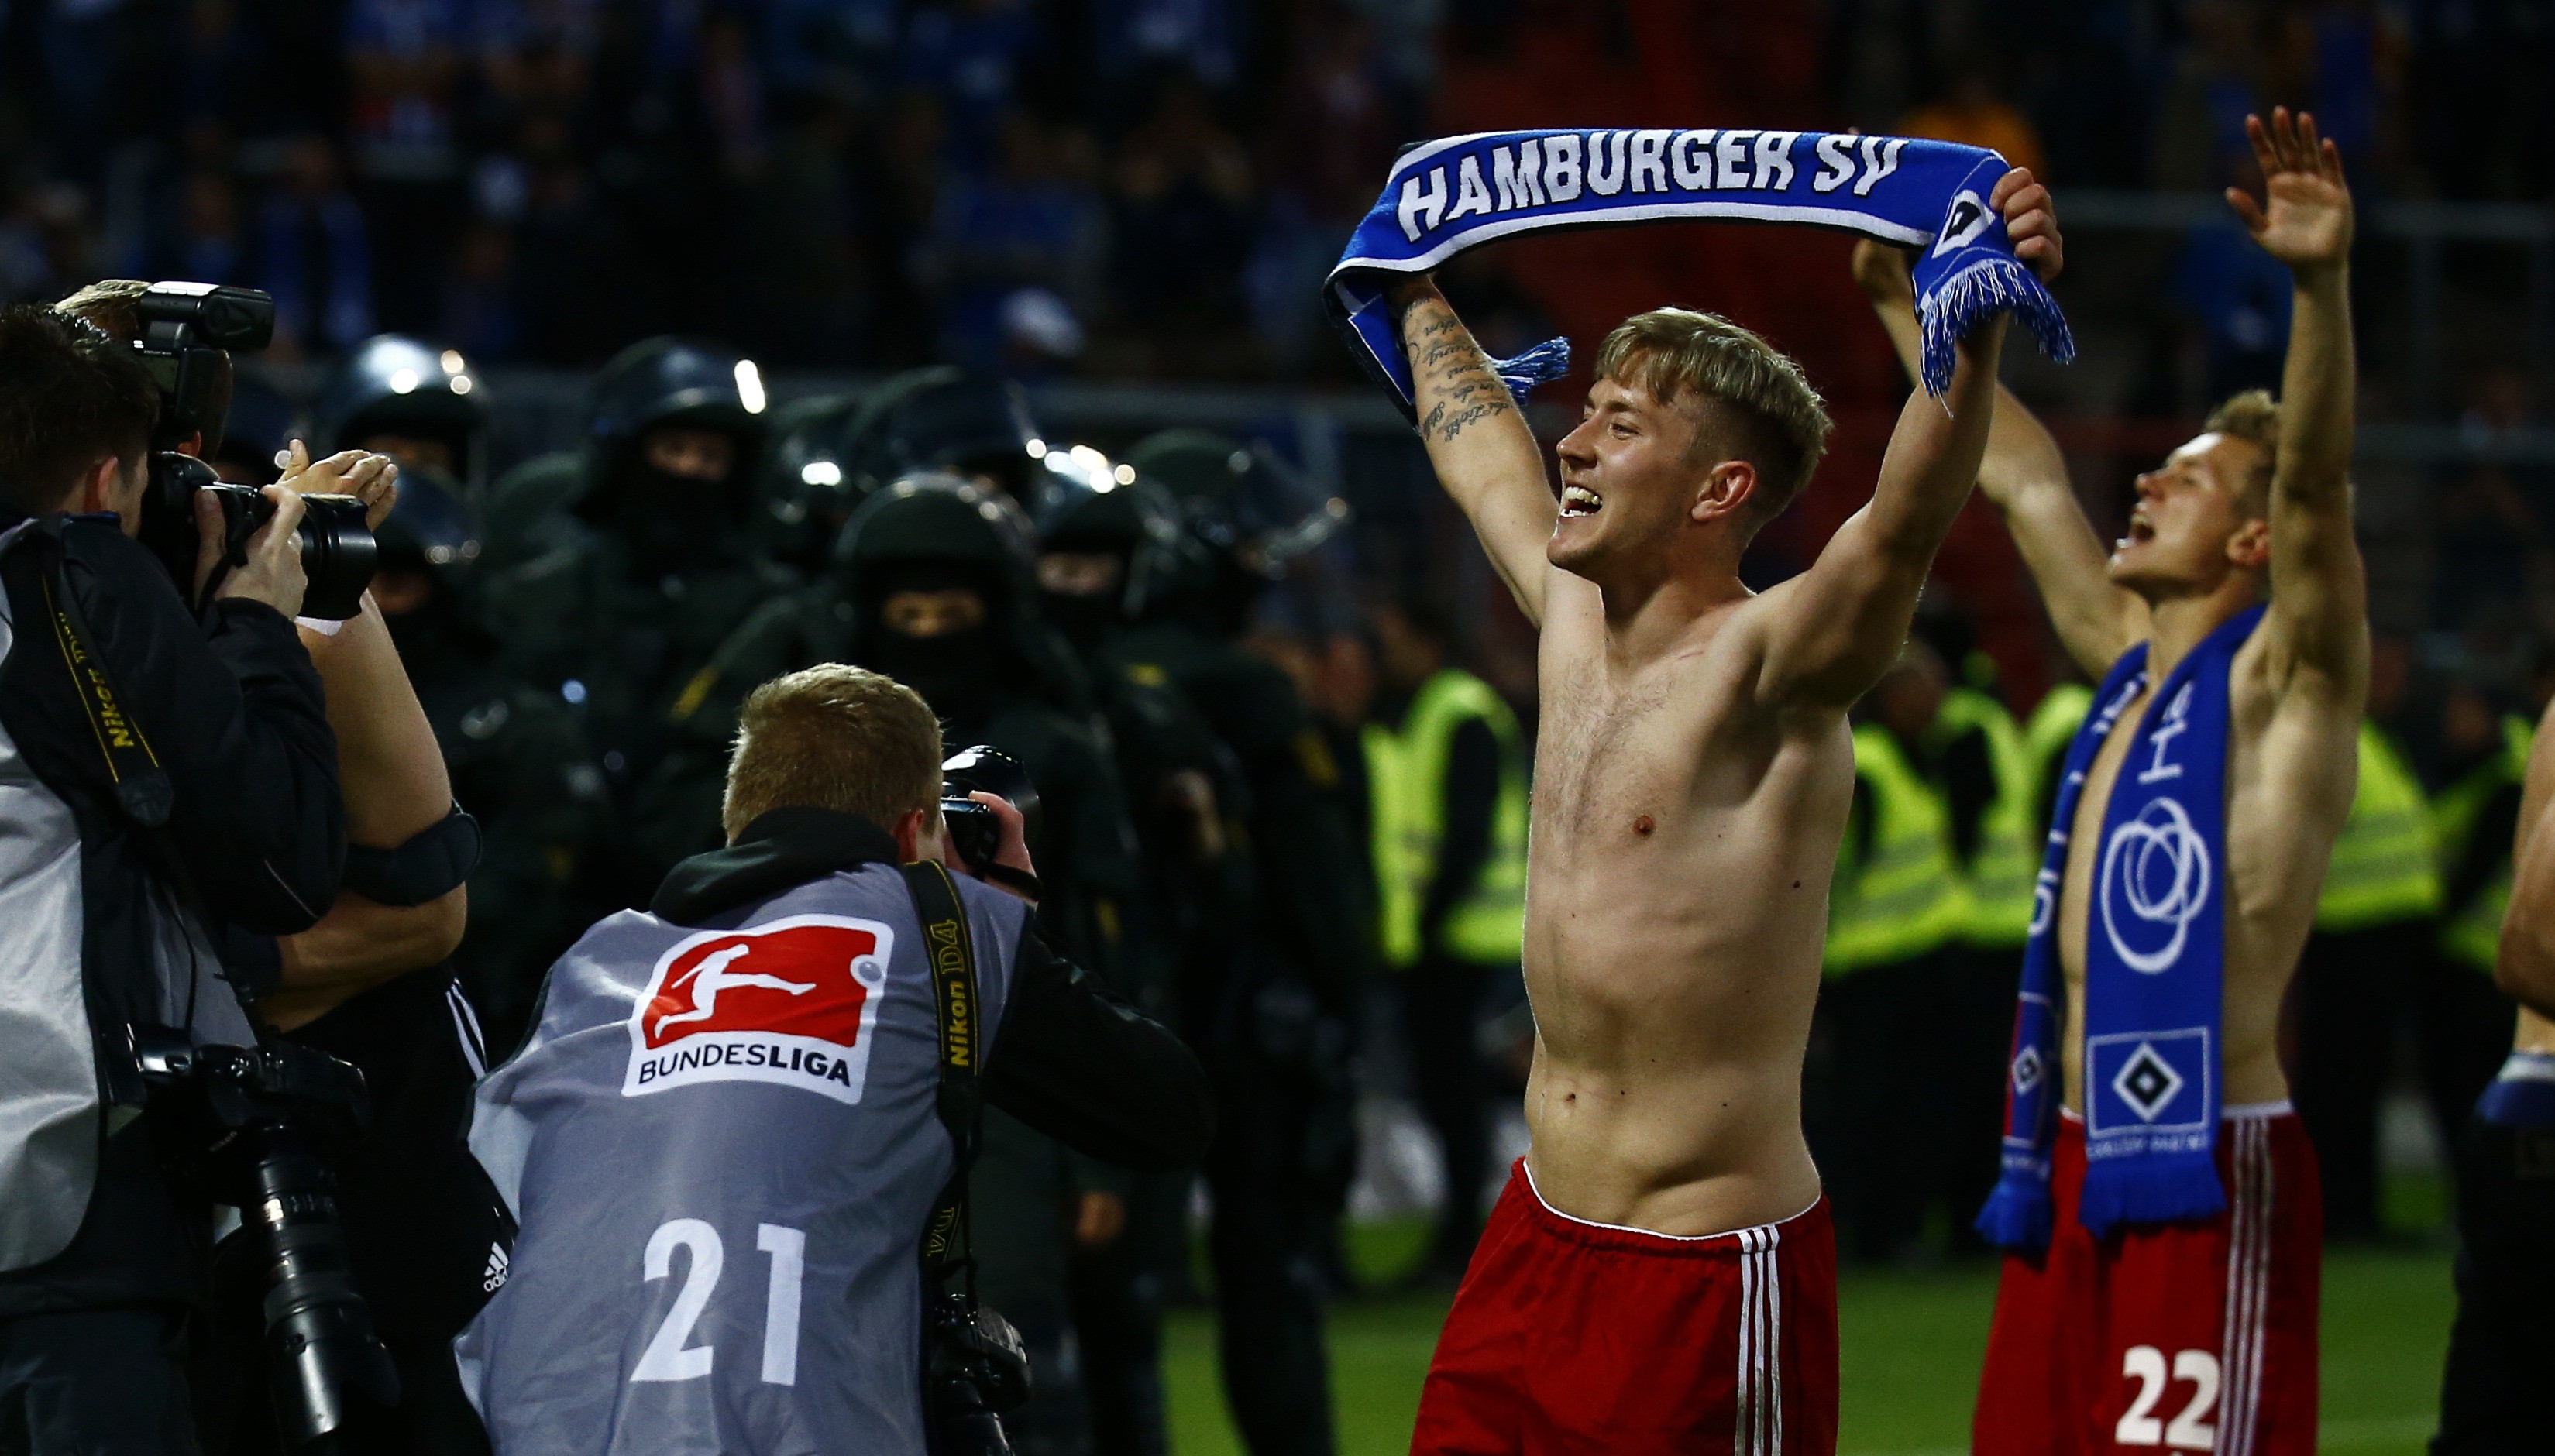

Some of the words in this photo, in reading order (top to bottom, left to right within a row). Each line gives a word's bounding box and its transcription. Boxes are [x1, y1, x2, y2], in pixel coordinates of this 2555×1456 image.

[1396, 129, 1801, 244] HAMBURGER
[1813, 133, 1910, 197] SV
[88, 667, 135, 748] Nikon
[930, 919, 965, 975] D4
[638, 1043, 851, 1088] BUNDESLIGA
[951, 980, 970, 1067] Nikon
[630, 1217, 806, 1387] 21
[2115, 1345, 2221, 1451] 22
